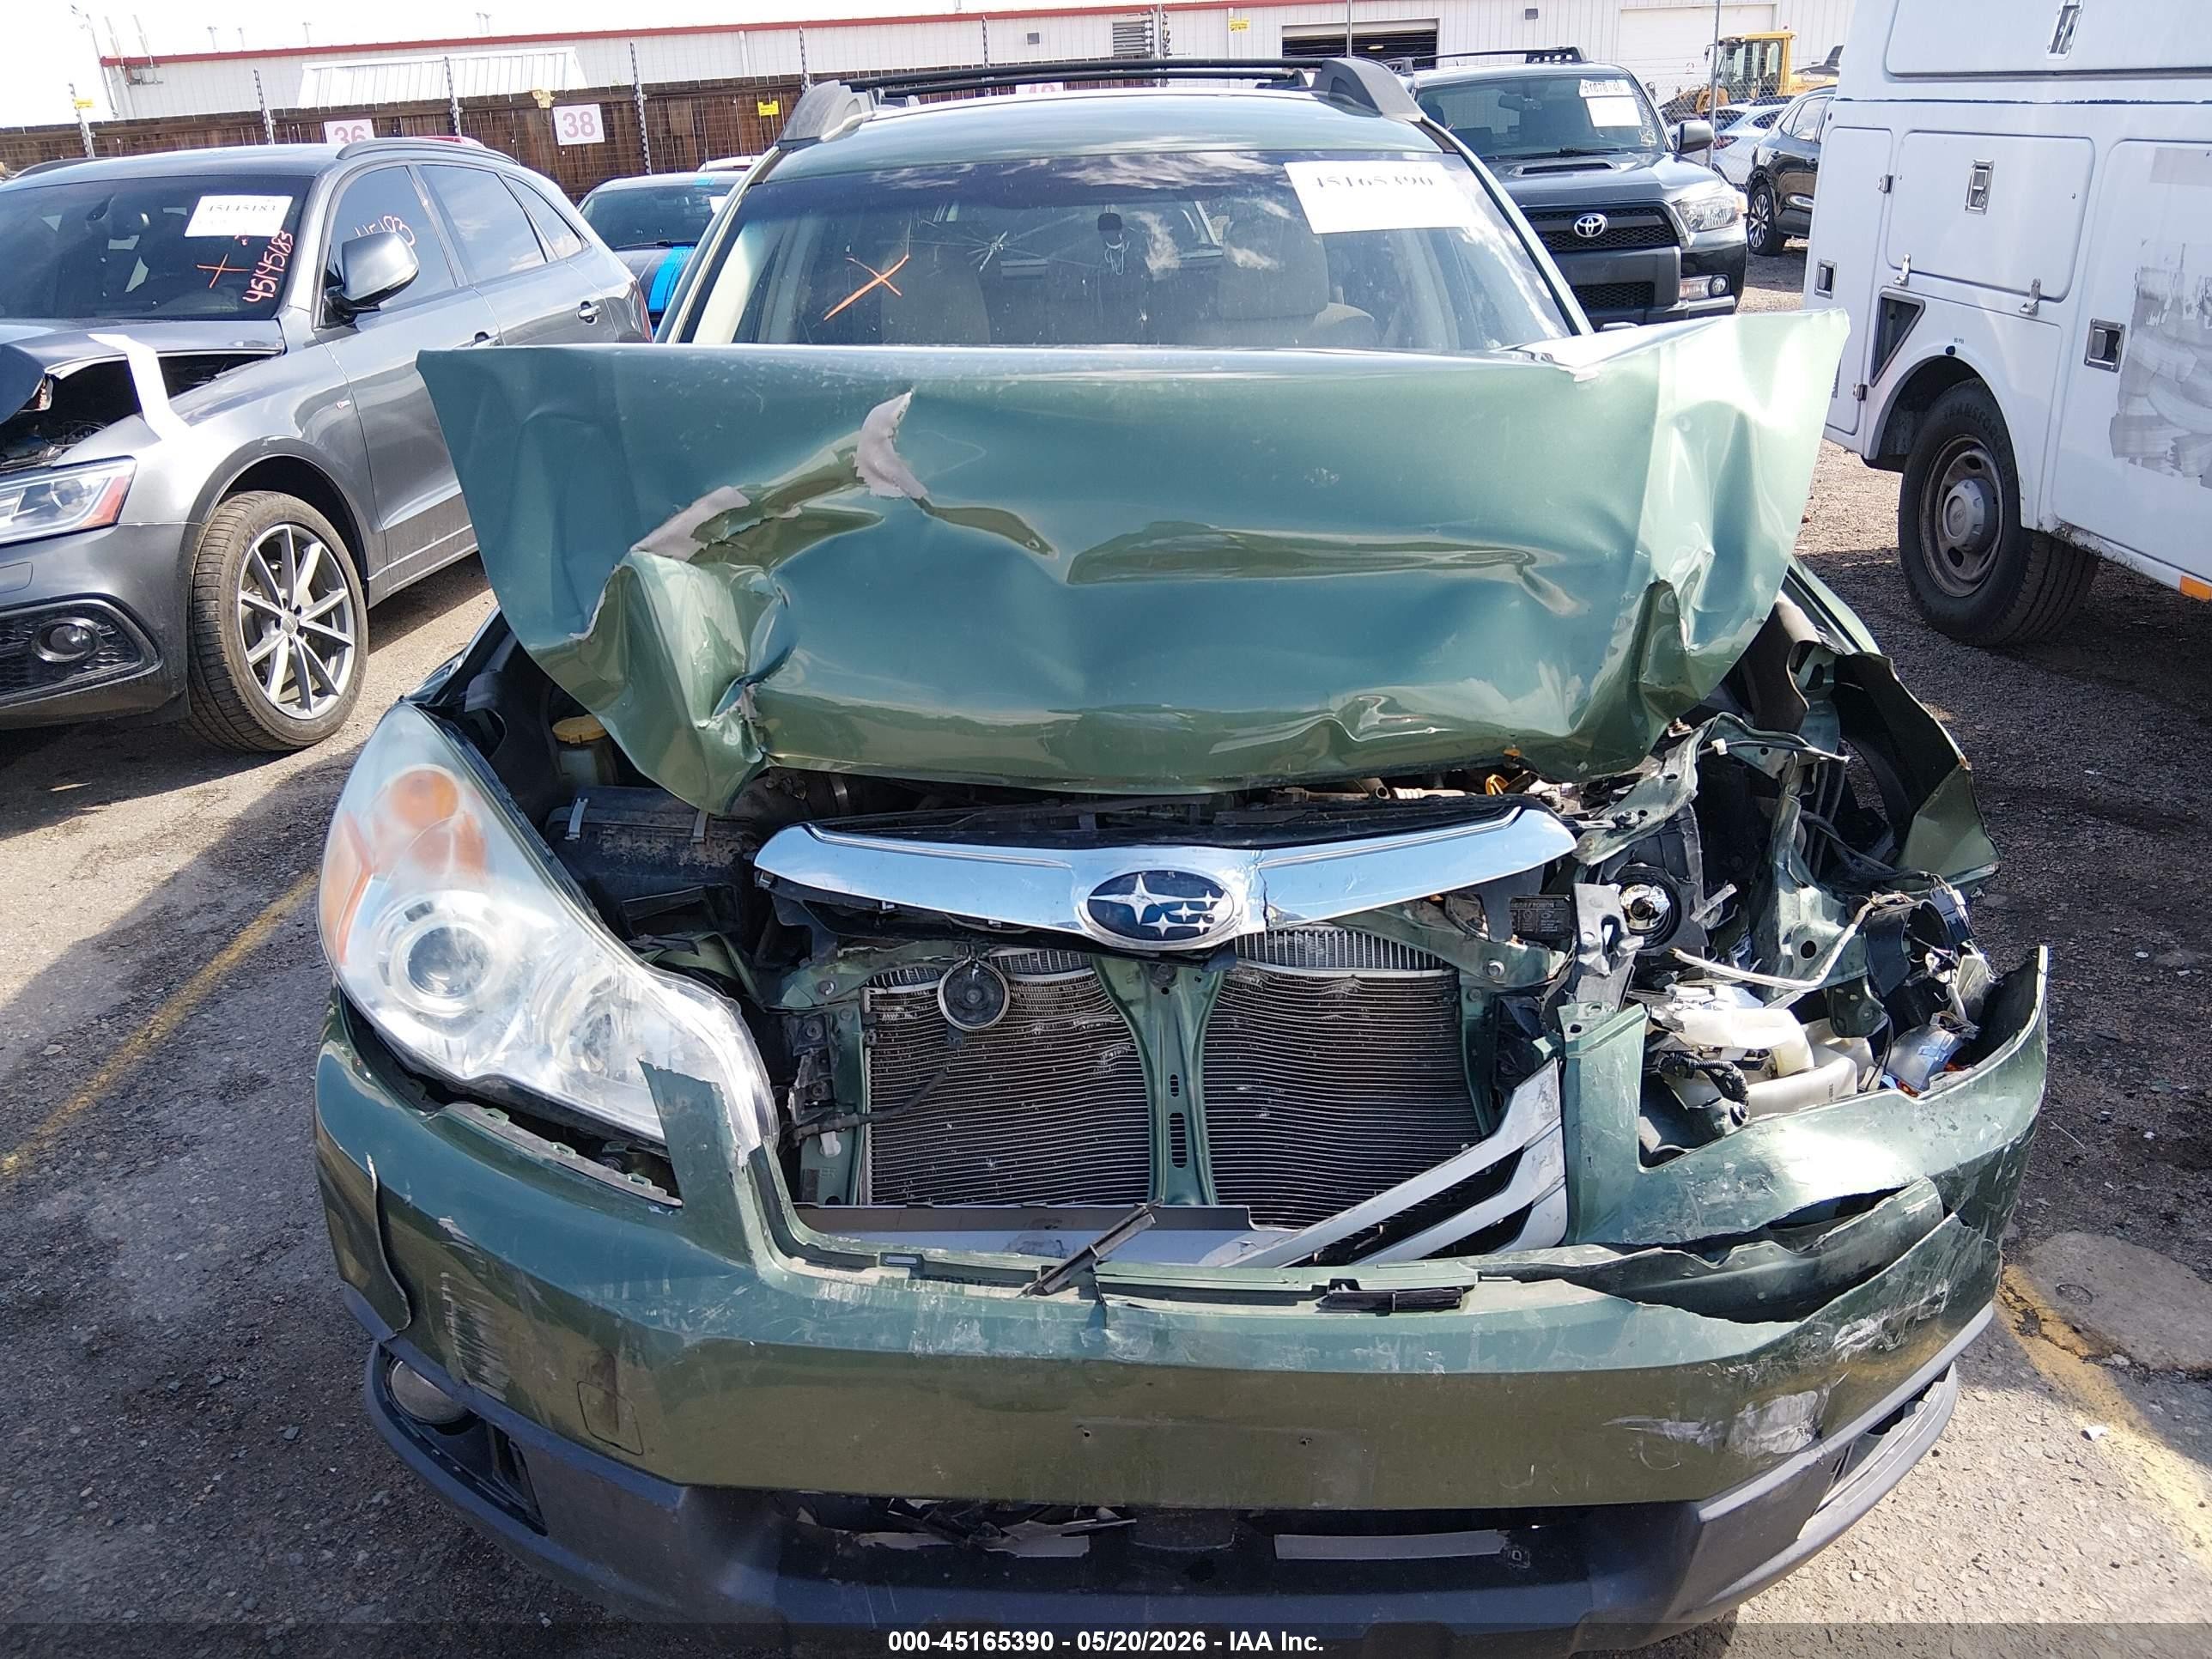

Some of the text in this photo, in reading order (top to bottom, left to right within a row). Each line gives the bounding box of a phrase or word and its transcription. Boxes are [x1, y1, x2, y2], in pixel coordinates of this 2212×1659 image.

[334, 125, 366, 143] 36
[563, 111, 596, 138] 38
[242, 230, 294, 302] 45145183
